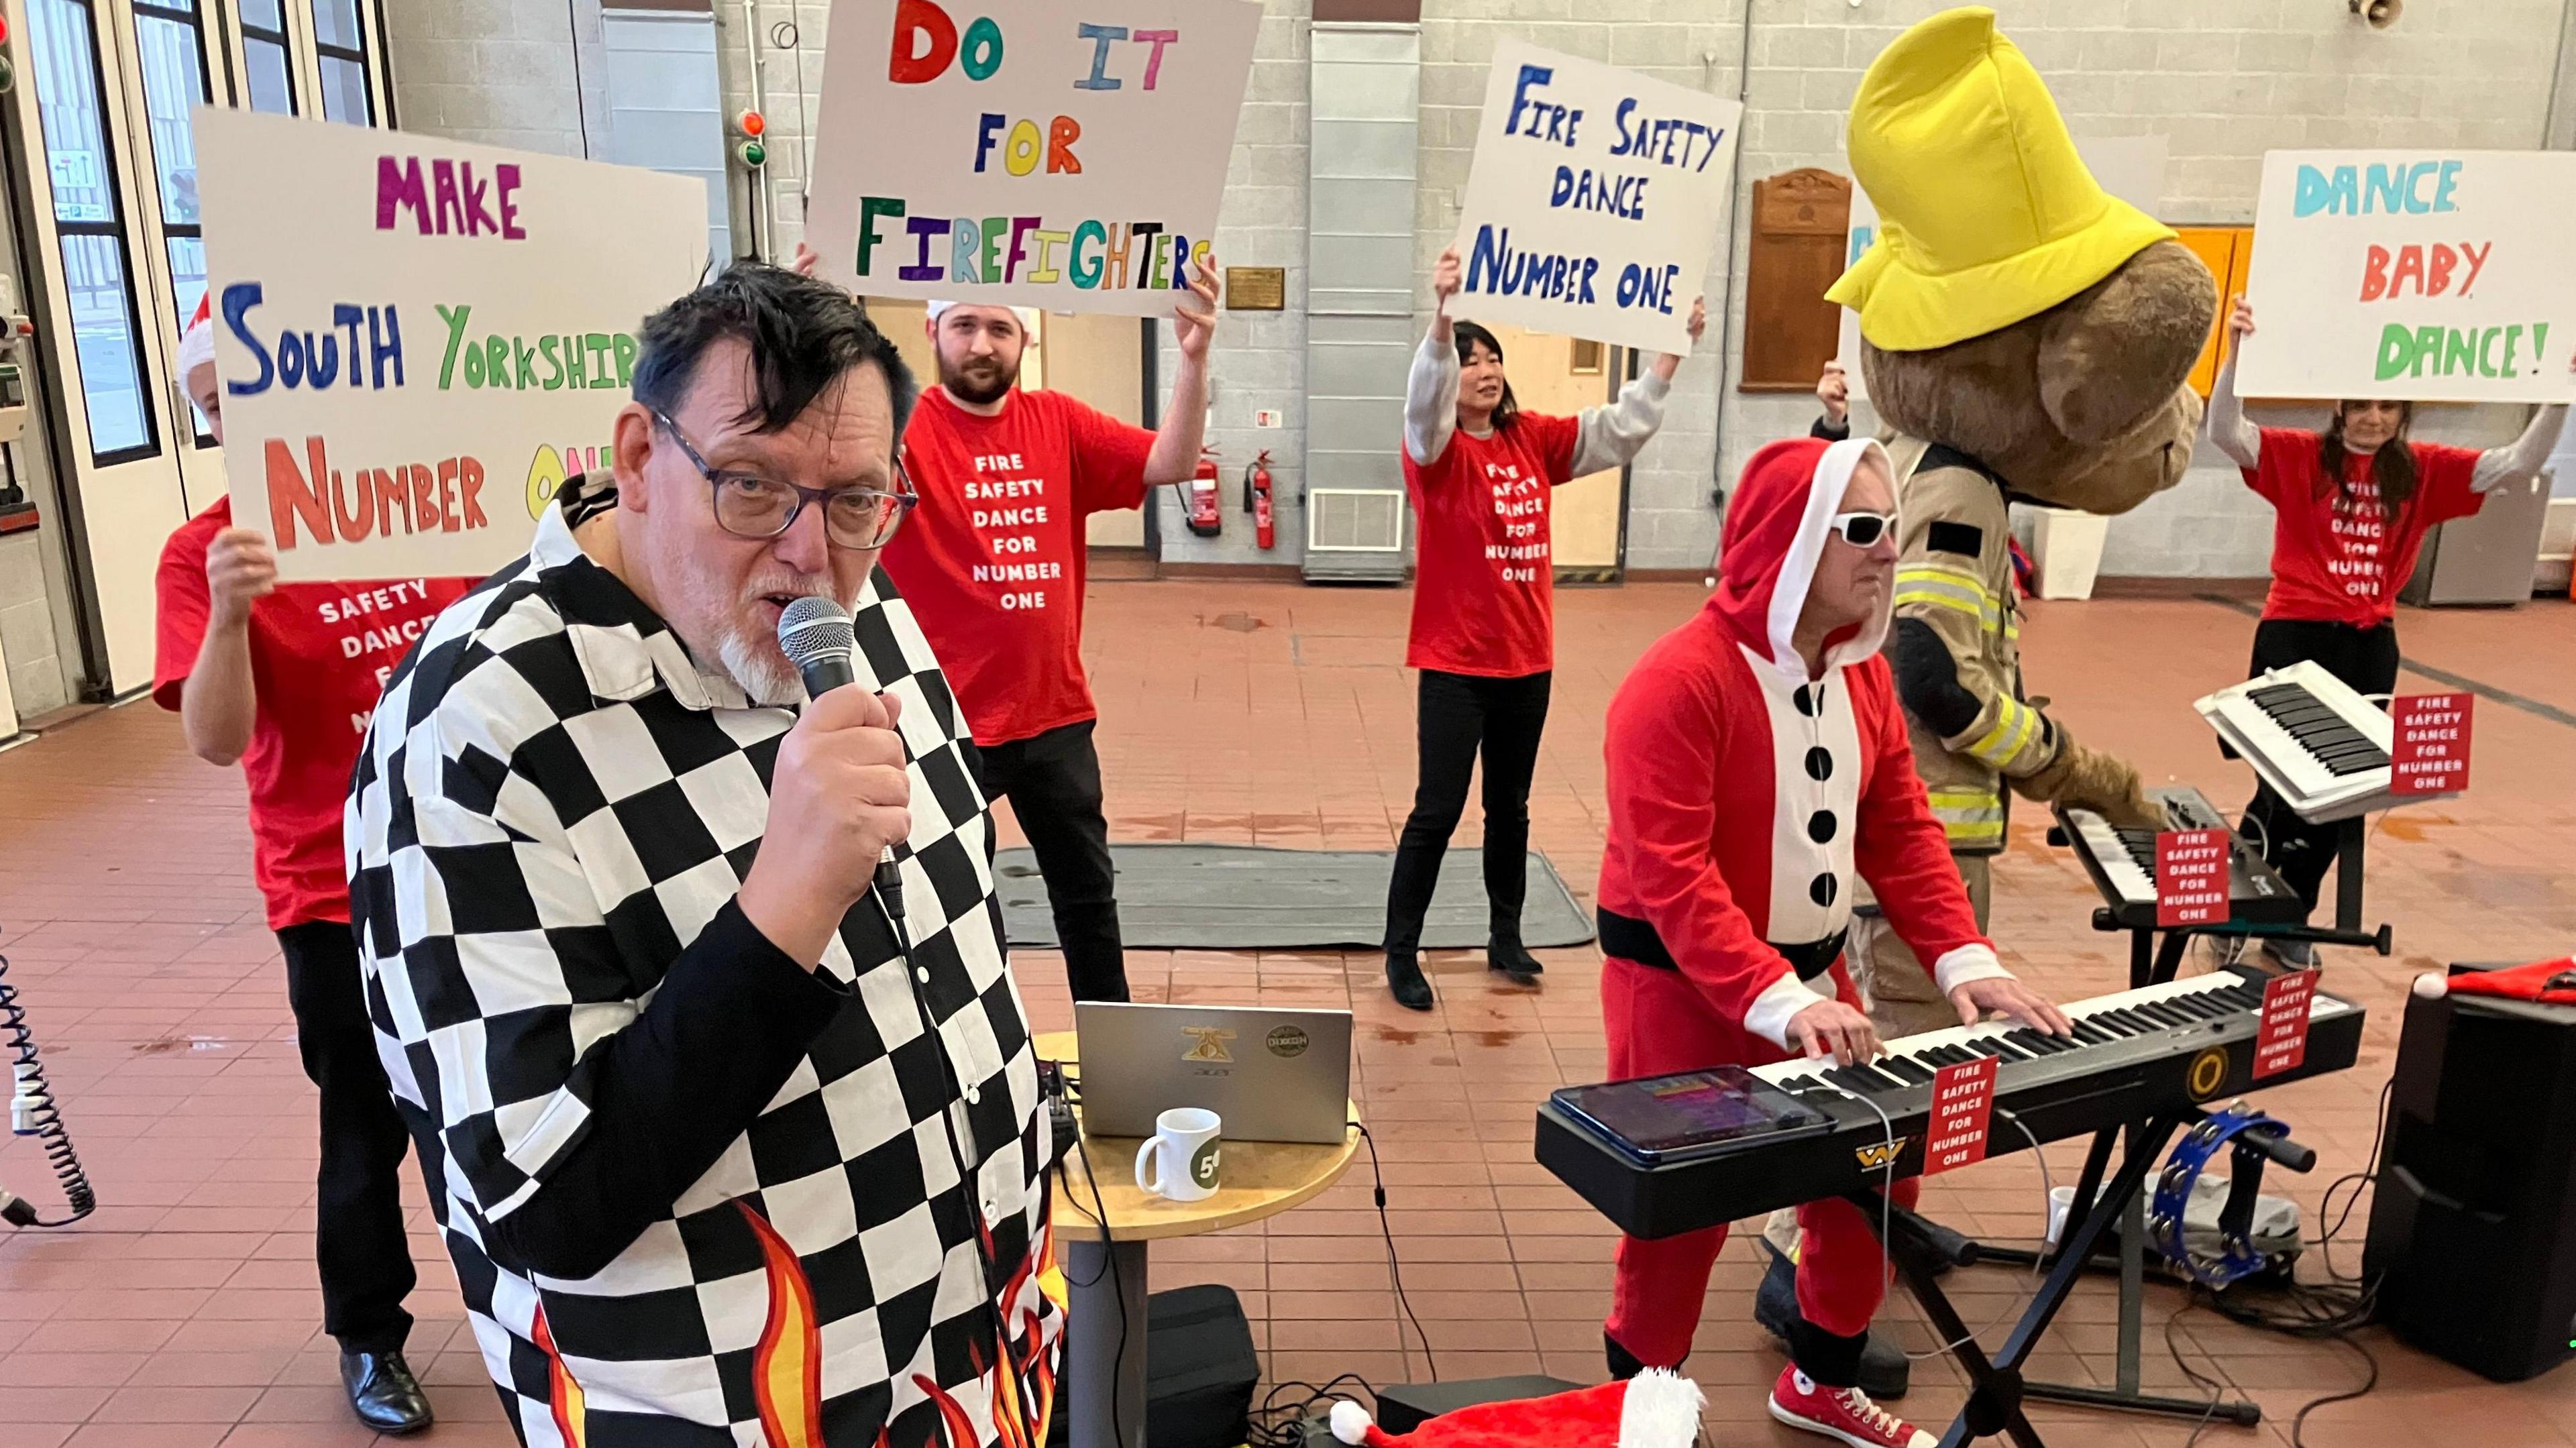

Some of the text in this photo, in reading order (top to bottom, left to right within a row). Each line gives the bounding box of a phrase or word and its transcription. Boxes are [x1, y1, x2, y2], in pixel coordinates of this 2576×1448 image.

[889, 0, 1179, 91] DO IT
[1505, 64, 1724, 172] FIRE SAFETY
[973, 113, 1082, 177] FOR
[376, 156, 527, 240] MAKE
[1550, 166, 1648, 220] DANCE
[856, 197, 1210, 291] FIREFIGHTERS
[1464, 224, 1679, 315] NUMBER ONE
[221, 282, 638, 394] SOUTH YORKSHIR
[2375, 322, 2549, 381] DANCE!
[975, 454, 1024, 471] FIRE
[264, 435, 488, 551] NUMBER
[965, 479, 1043, 498] SAFETY
[973, 506, 1048, 527] DANCE
[1506, 522, 1536, 538] FOR
[2332, 518, 2381, 537] DANC
[993, 536, 1036, 554] FOR
[1485, 543, 1548, 559] NUMBER
[973, 563, 1061, 582] NUMBER
[1502, 567, 1536, 582] ONE
[319, 578, 427, 623] SAFETY
[1000, 592, 1045, 610] ONE
[2417, 696, 2451, 709] FIRE
[2404, 712, 2461, 726] SAFETY
[2406, 728, 2458, 742] DANCE
[2416, 744, 2446, 757] FOR
[2399, 759, 2462, 773] NUMBER
[2414, 776, 2445, 789] ONE
[2178, 833, 2208, 845] FIRE
[2167, 848, 2218, 861] SAFETY
[2169, 862, 2216, 876] DANCE
[2180, 879, 2206, 890] FOR
[2164, 893, 2222, 906] NUMBER
[2179, 909, 2208, 920] ONE
[1953, 1064, 1980, 1080] FIRE
[1942, 1079, 1987, 1100] SAFETY
[1941, 1097, 1982, 1117] DANCE
[1948, 1116, 1972, 1131] FOR
[1932, 1129, 1982, 1152] NUMBER
[1943, 1150, 1968, 1166] ONE
